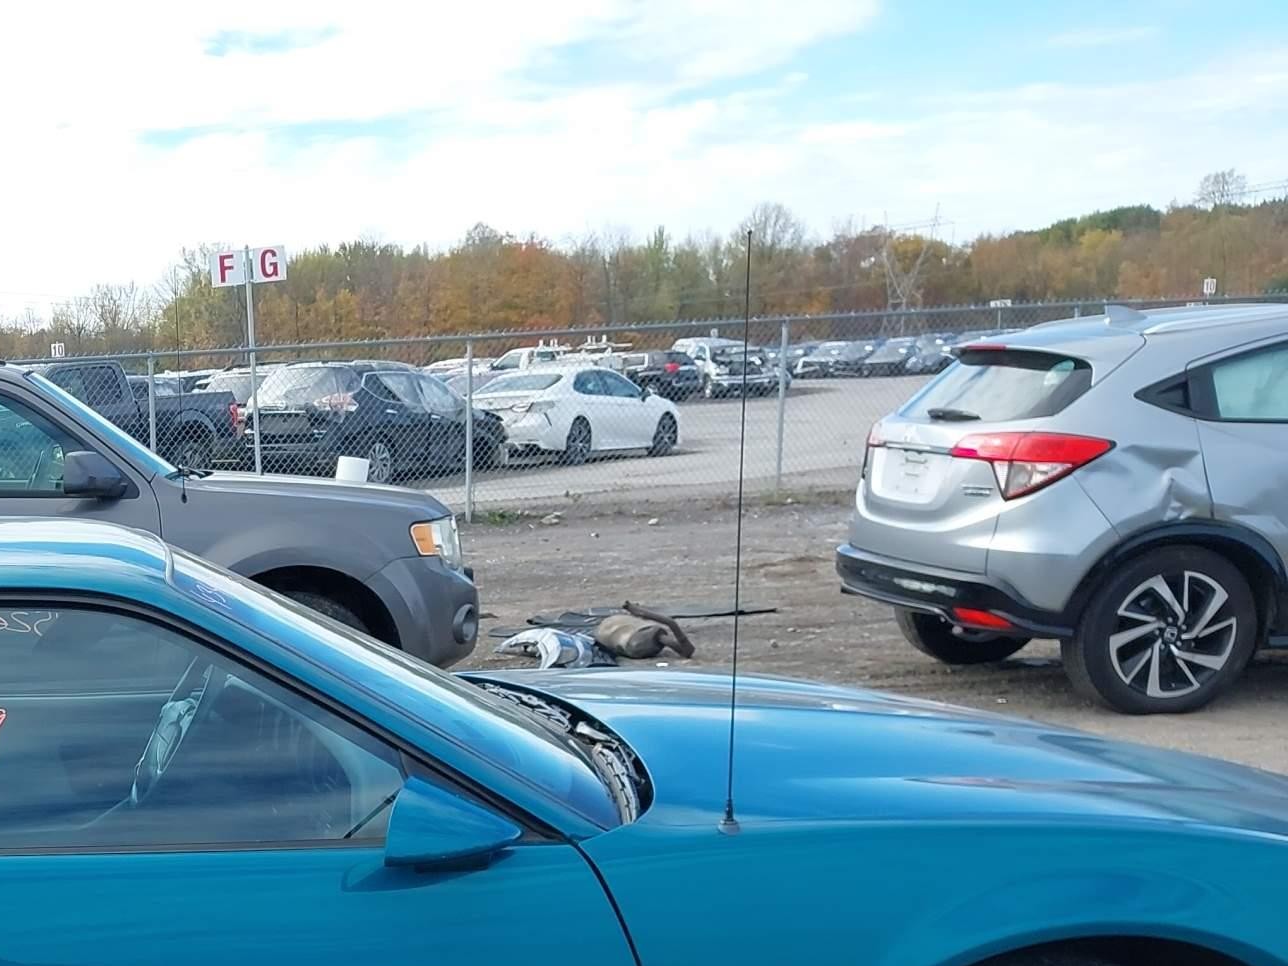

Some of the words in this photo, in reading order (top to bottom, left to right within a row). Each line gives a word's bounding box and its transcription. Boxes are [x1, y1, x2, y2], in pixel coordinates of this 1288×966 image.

[218, 253, 235, 283] F
[260, 249, 279, 279] G
[52, 345, 64, 356] 10
